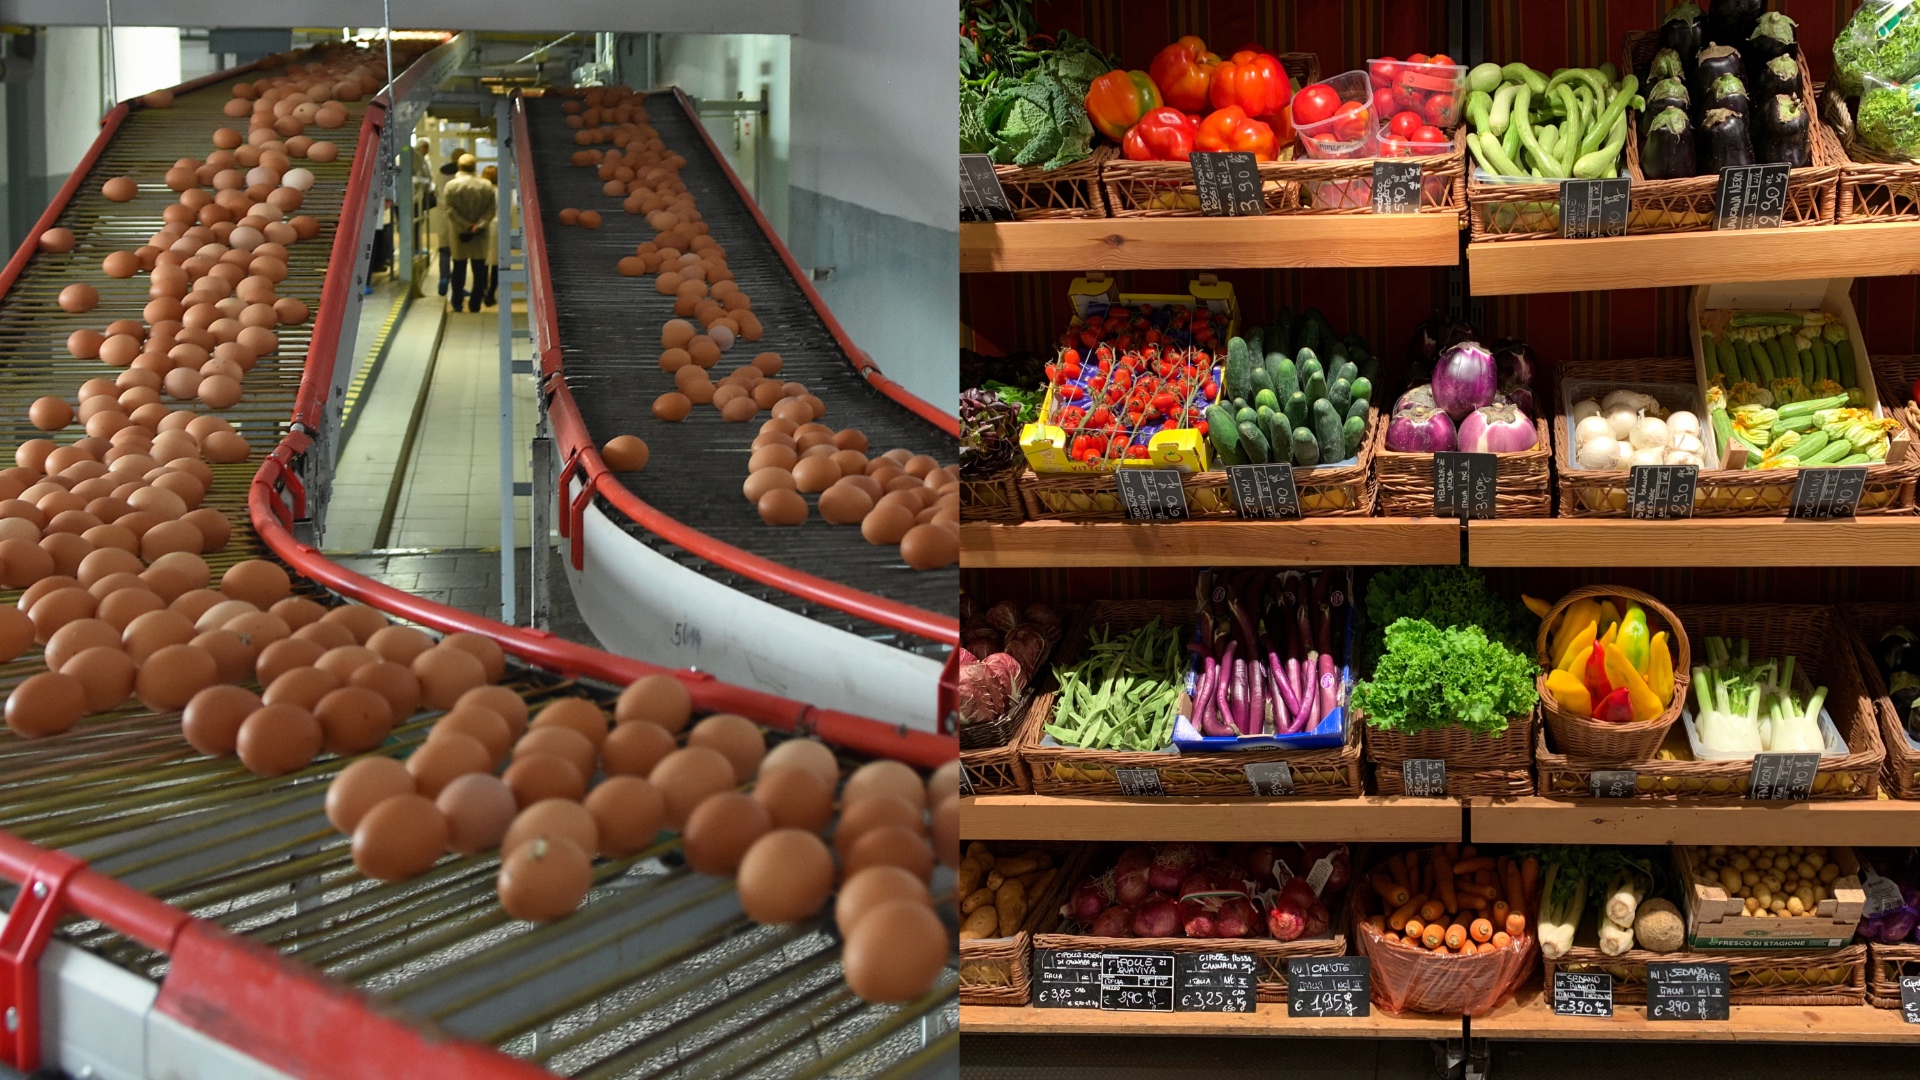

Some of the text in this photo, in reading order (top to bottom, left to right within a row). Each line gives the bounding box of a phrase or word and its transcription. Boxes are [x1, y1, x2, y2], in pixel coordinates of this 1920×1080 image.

[1669, 967, 1706, 977] SEDANO
[1566, 974, 1600, 984] SEDANO
[1570, 982, 1596, 990] BIANCO
[1039, 988, 1071, 1002] € 3,25
[1182, 991, 1223, 1010] € 3,25
[1295, 993, 1342, 1017] € 1,95
[1567, 1000, 1592, 1014] 3,90
[1654, 1004, 1663, 1016] €
[1904, 1002, 1919, 1011] €
